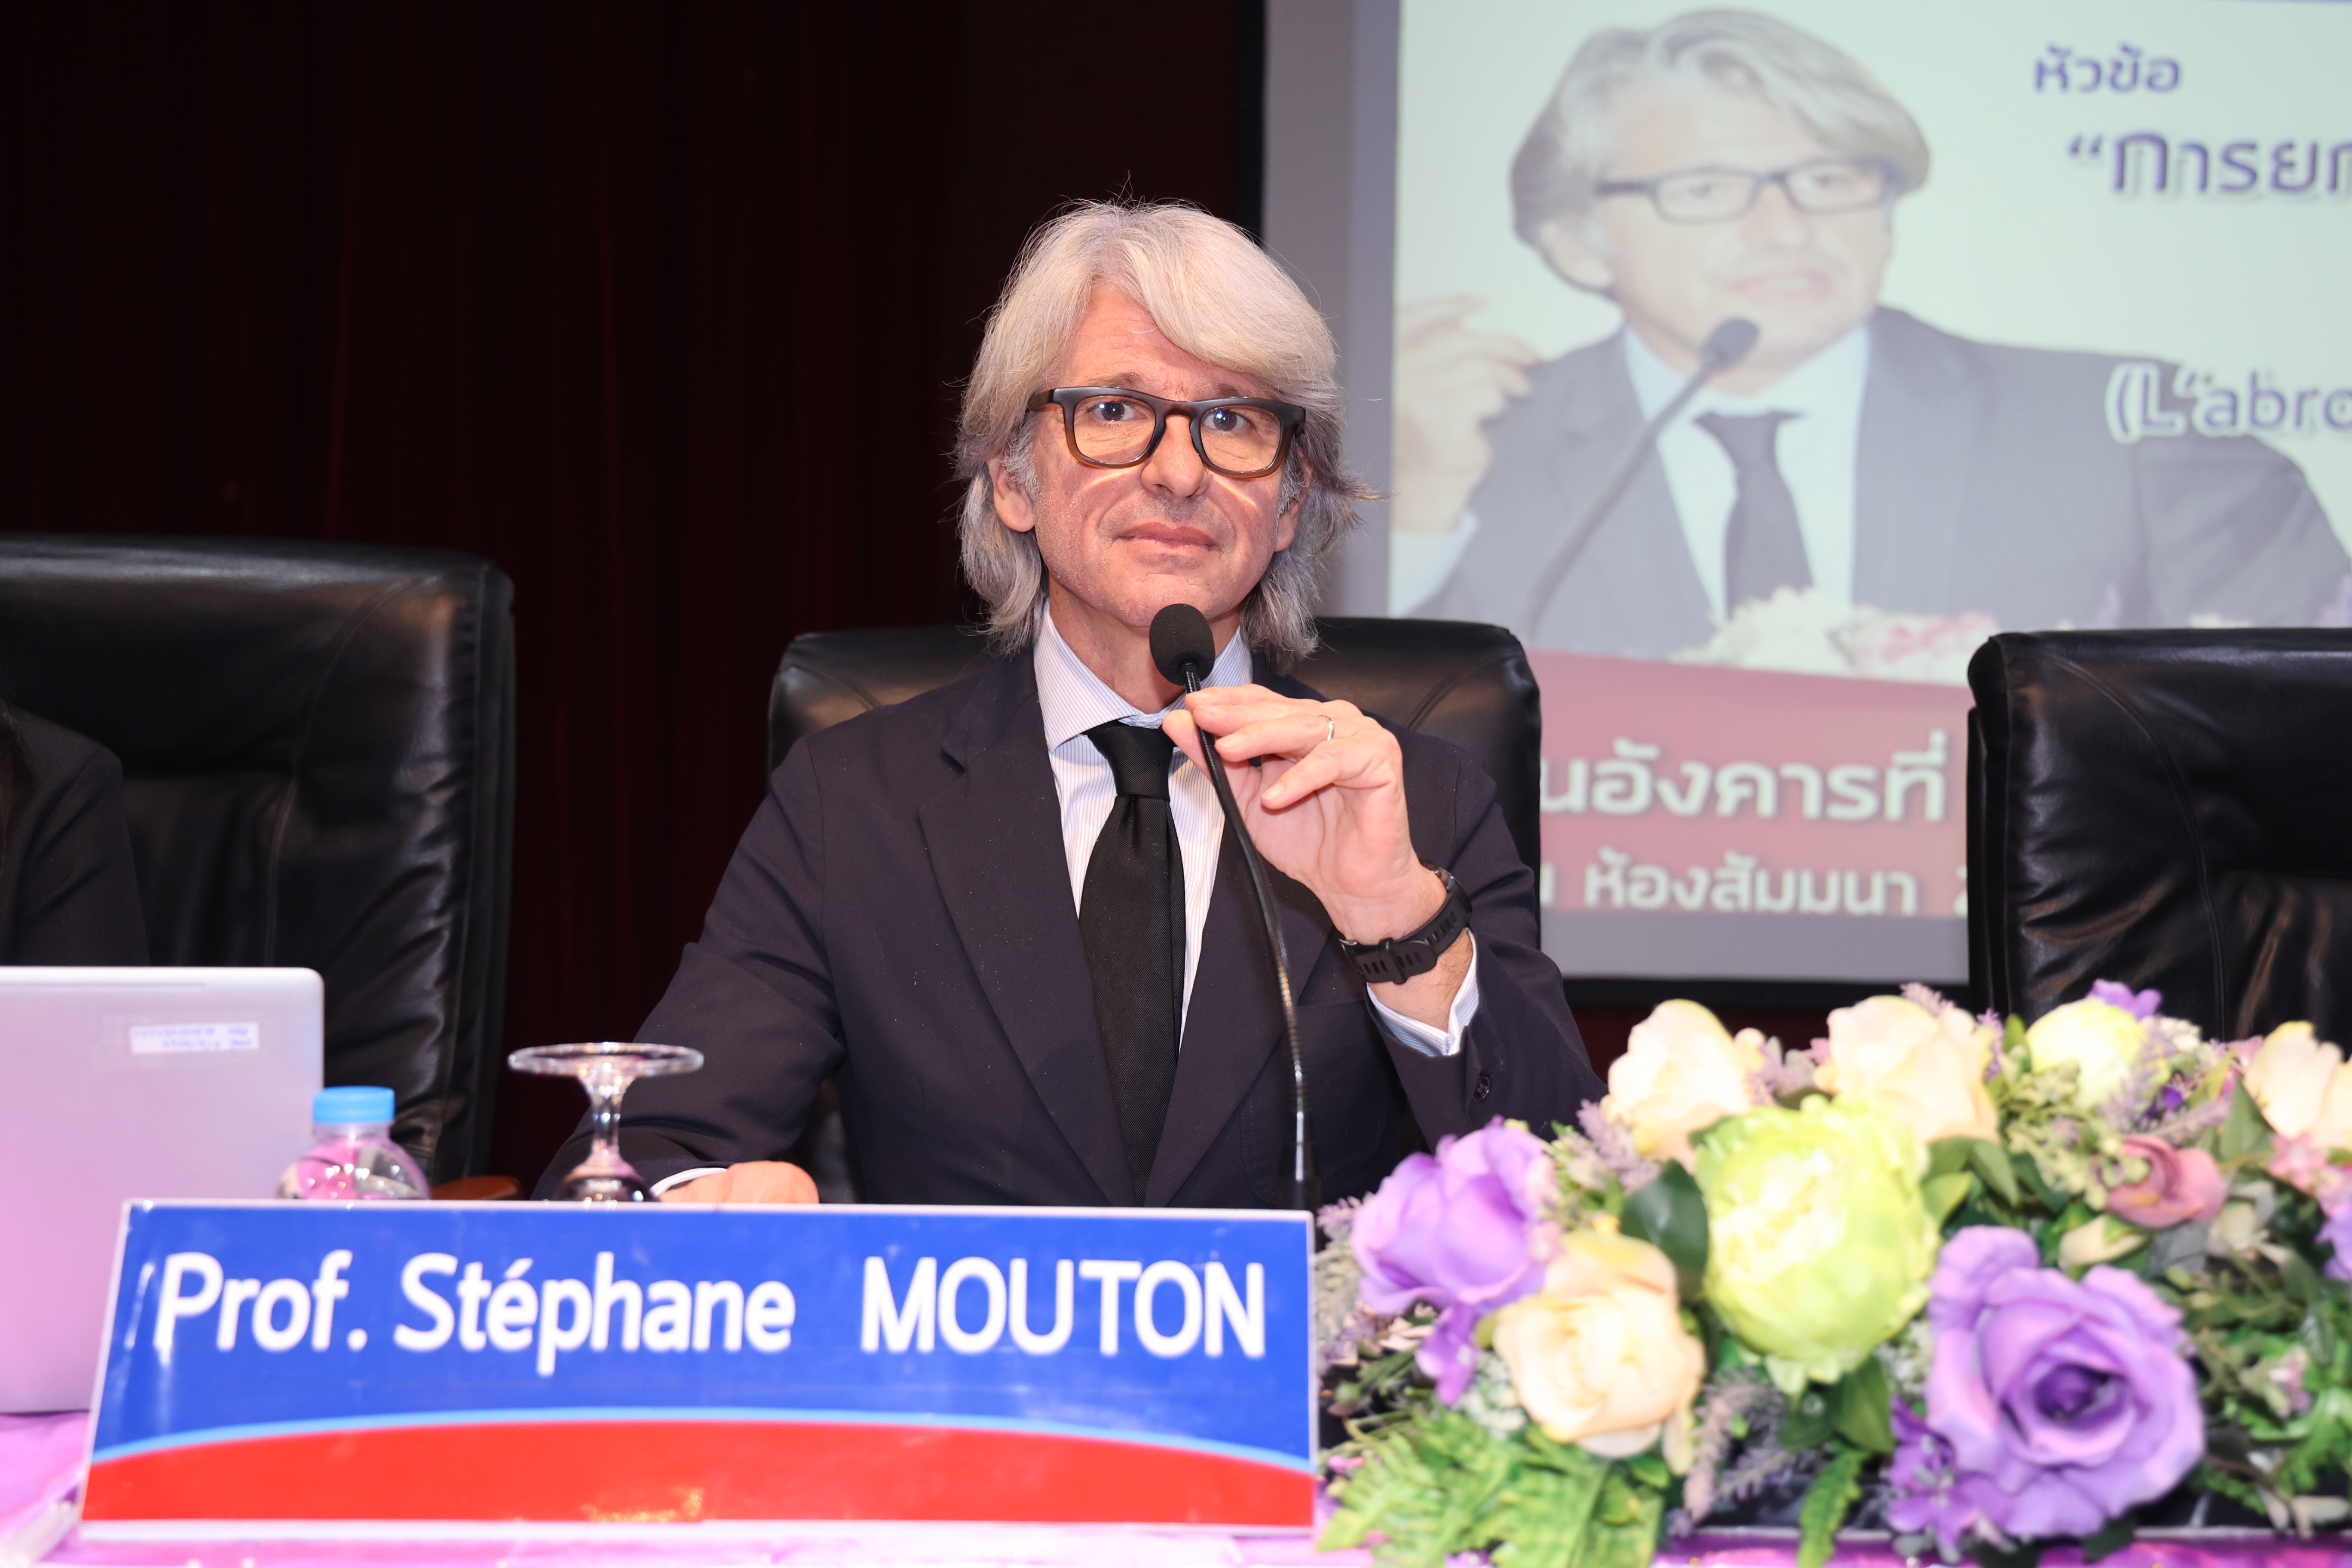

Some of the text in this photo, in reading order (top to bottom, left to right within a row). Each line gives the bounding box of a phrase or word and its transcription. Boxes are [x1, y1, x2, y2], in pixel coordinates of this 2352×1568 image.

[1584, 846, 1918, 915] ห้องสัมมนา
[153, 1249, 1265, 1375] Prof. Stéphane MOUTON
